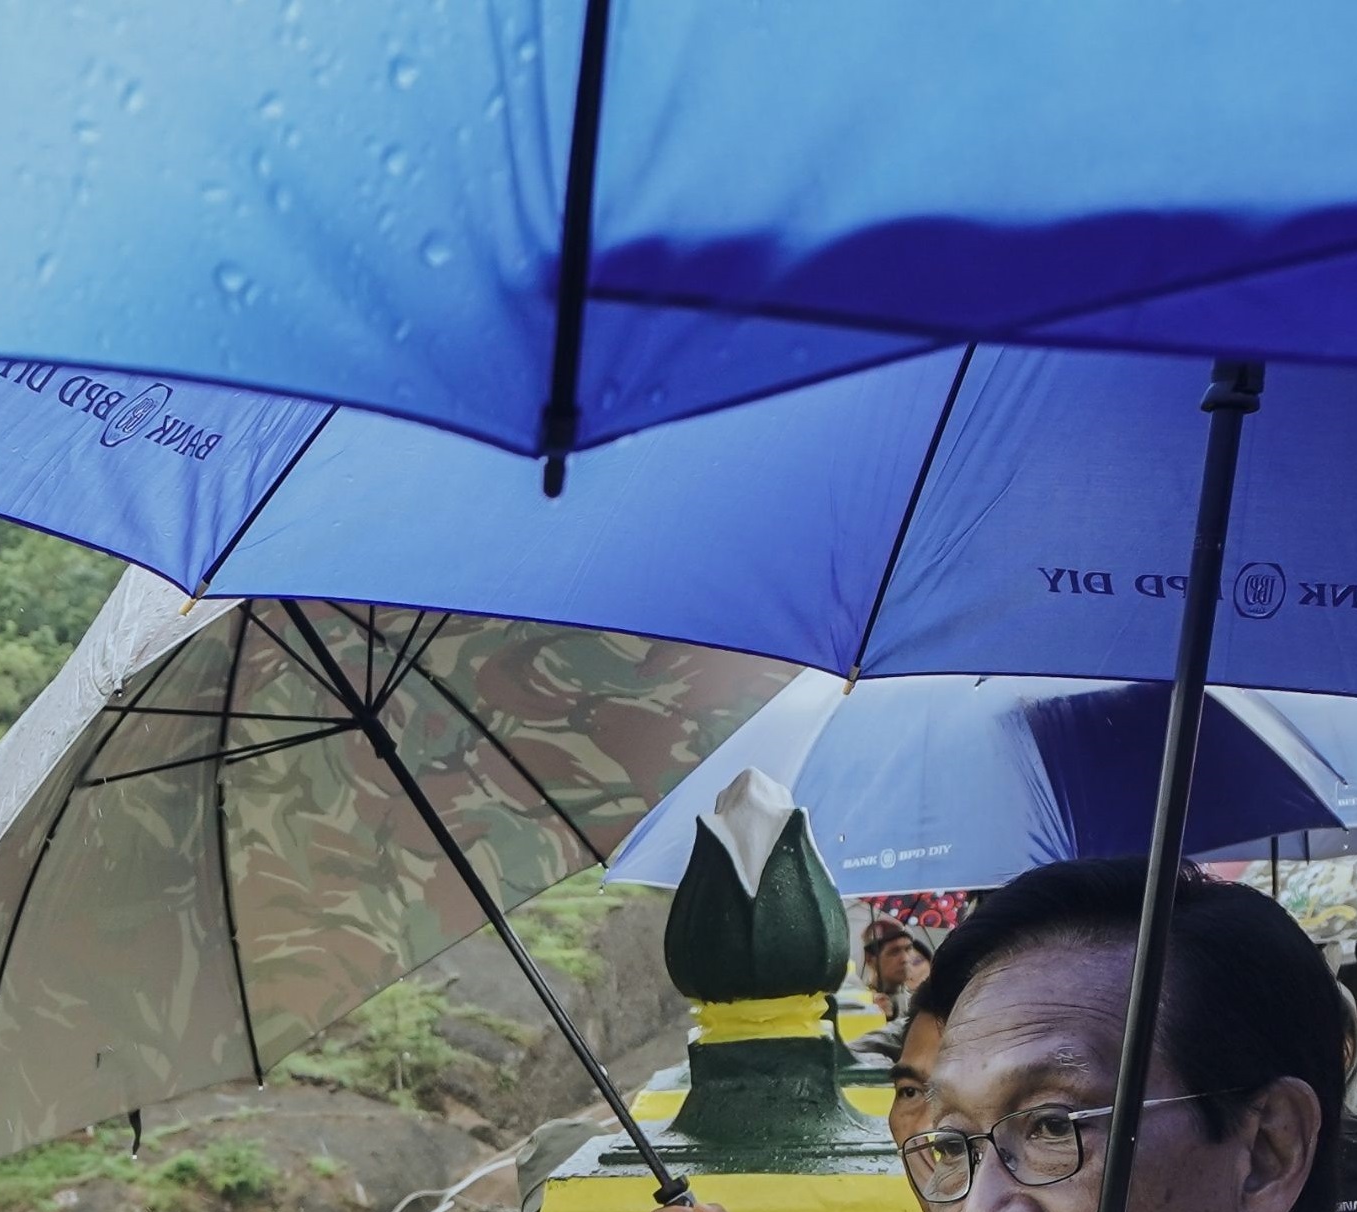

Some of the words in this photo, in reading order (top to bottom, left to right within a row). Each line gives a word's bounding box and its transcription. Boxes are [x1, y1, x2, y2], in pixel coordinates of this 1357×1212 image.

[843, 856, 878, 869] BANK
[898, 848, 926, 861] BPD
[929, 844, 953, 856] DIY
